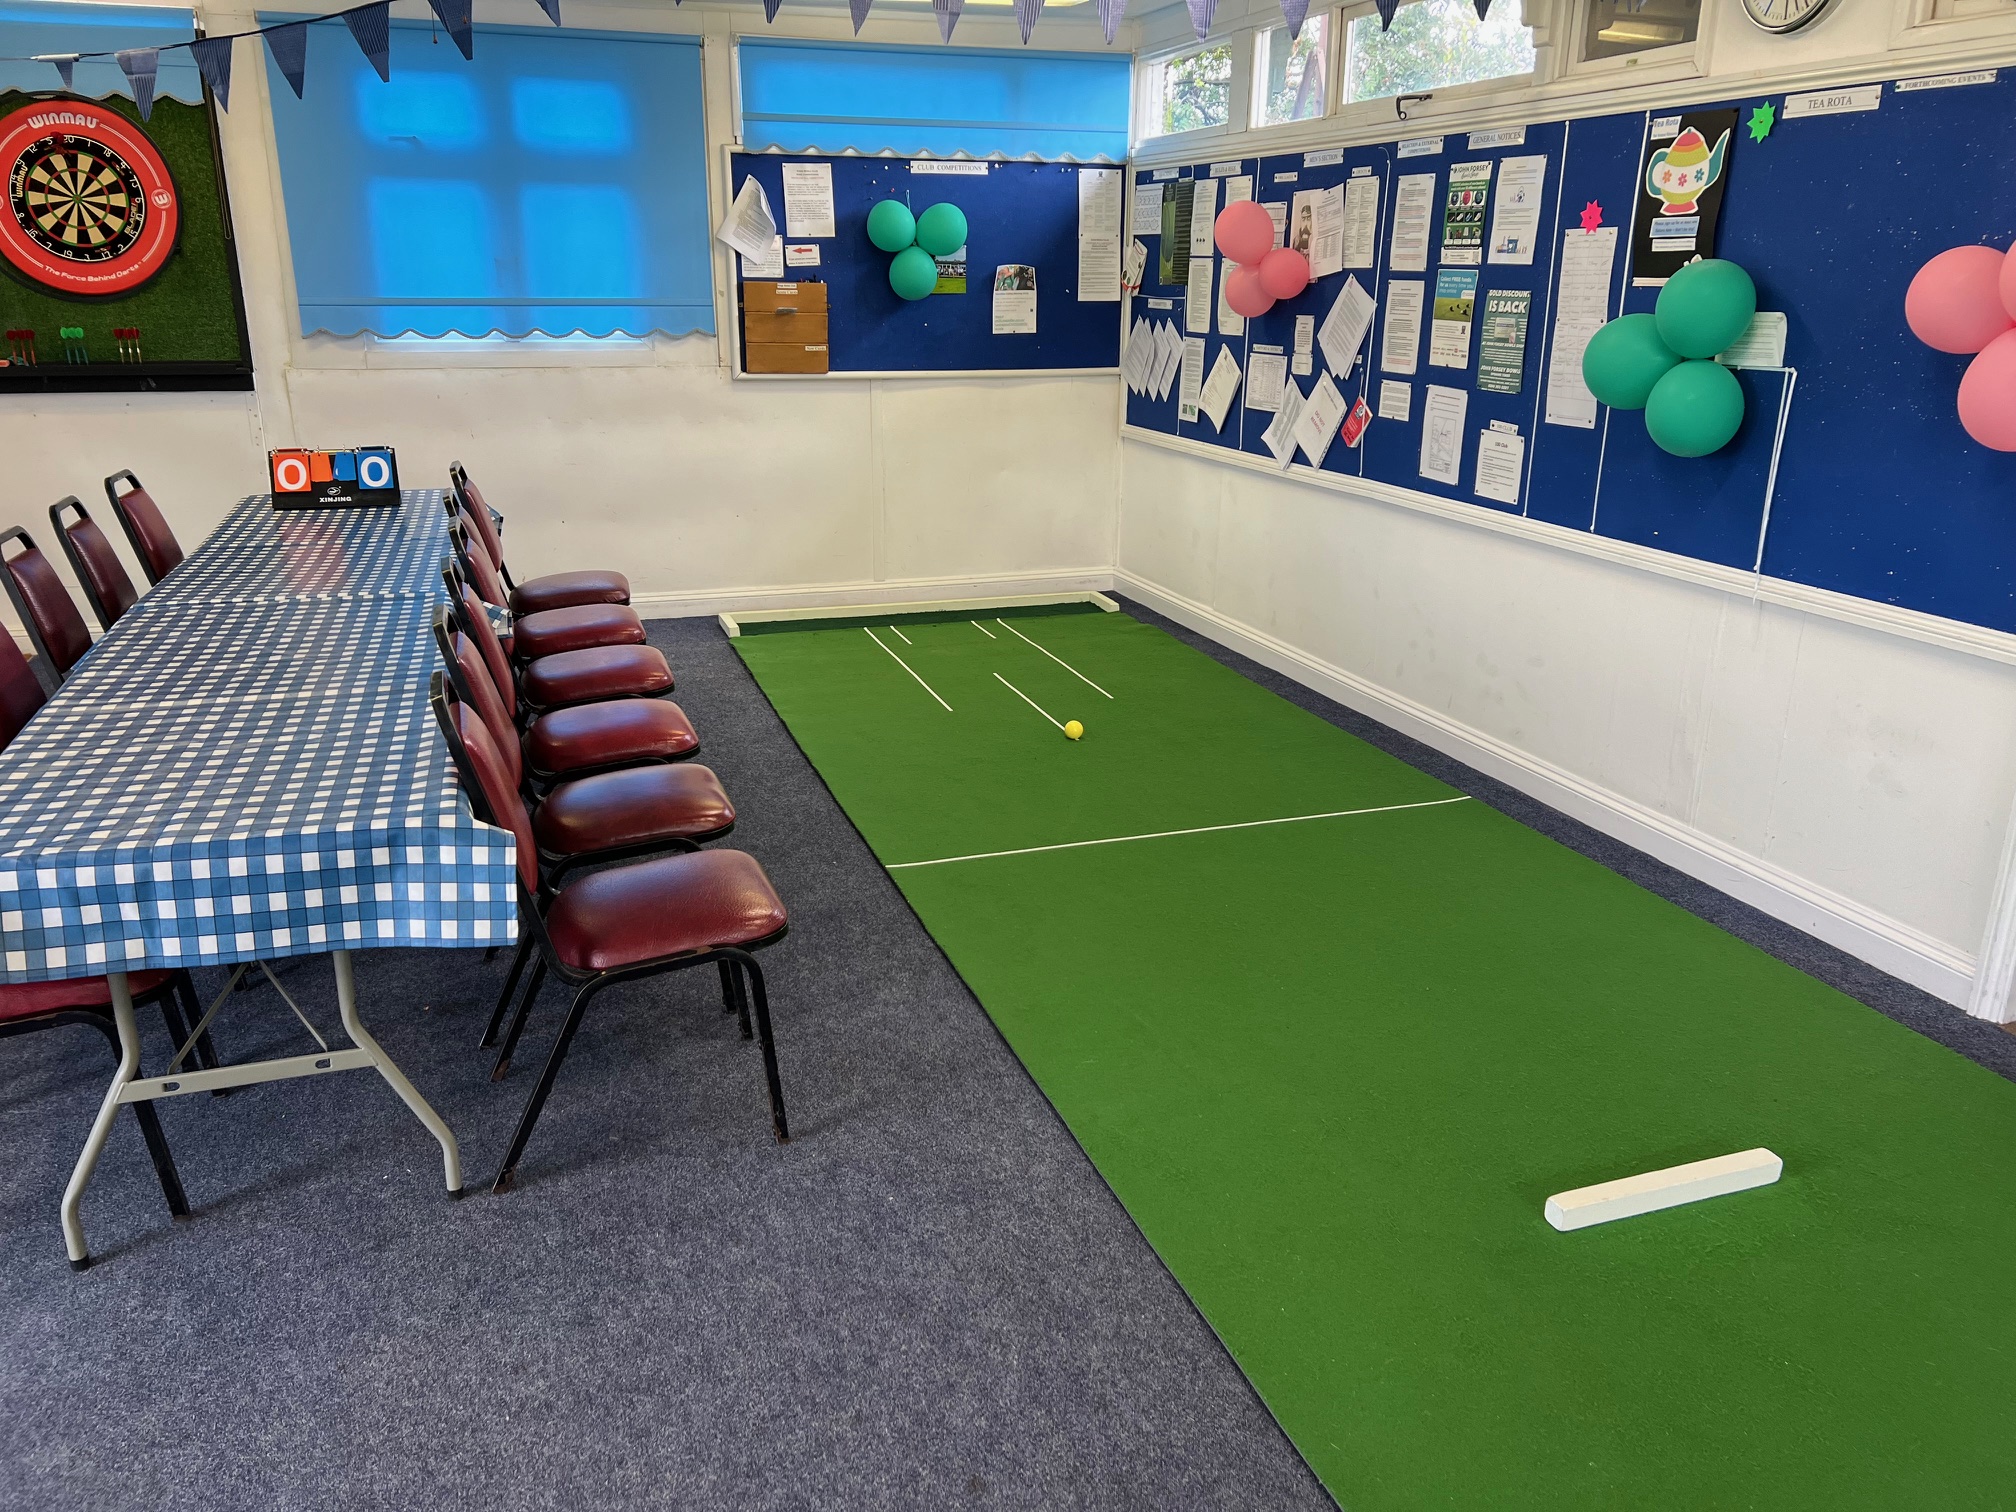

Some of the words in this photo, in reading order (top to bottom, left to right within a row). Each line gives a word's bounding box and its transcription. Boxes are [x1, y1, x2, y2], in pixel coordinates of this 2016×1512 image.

[1905, 77, 1956, 89] FORTHCOMING
[1958, 74, 1986, 84] EVENTS
[1808, 99, 1824, 109] TEA
[1827, 96, 1852, 107] ROTA
[28, 112, 97, 128] WINMAU
[1473, 134, 1496, 144] GENERAL
[1497, 131, 1521, 141] NOTICES
[104, 148, 112, 157] 18
[16, 166, 28, 197] WINMAU
[64, 250, 73, 258] 19
[45, 265, 60, 275] The
[61, 272, 86, 281] Force
[88, 273, 116, 282] Behind
[116, 264, 139, 277] Darts
[1502, 290, 1531, 298] DISCOUNT
[1489, 300, 1498, 312] IS
[1498, 300, 1527, 314] BACK
[277, 458, 307, 490] 0
[361, 456, 389, 487] 0
